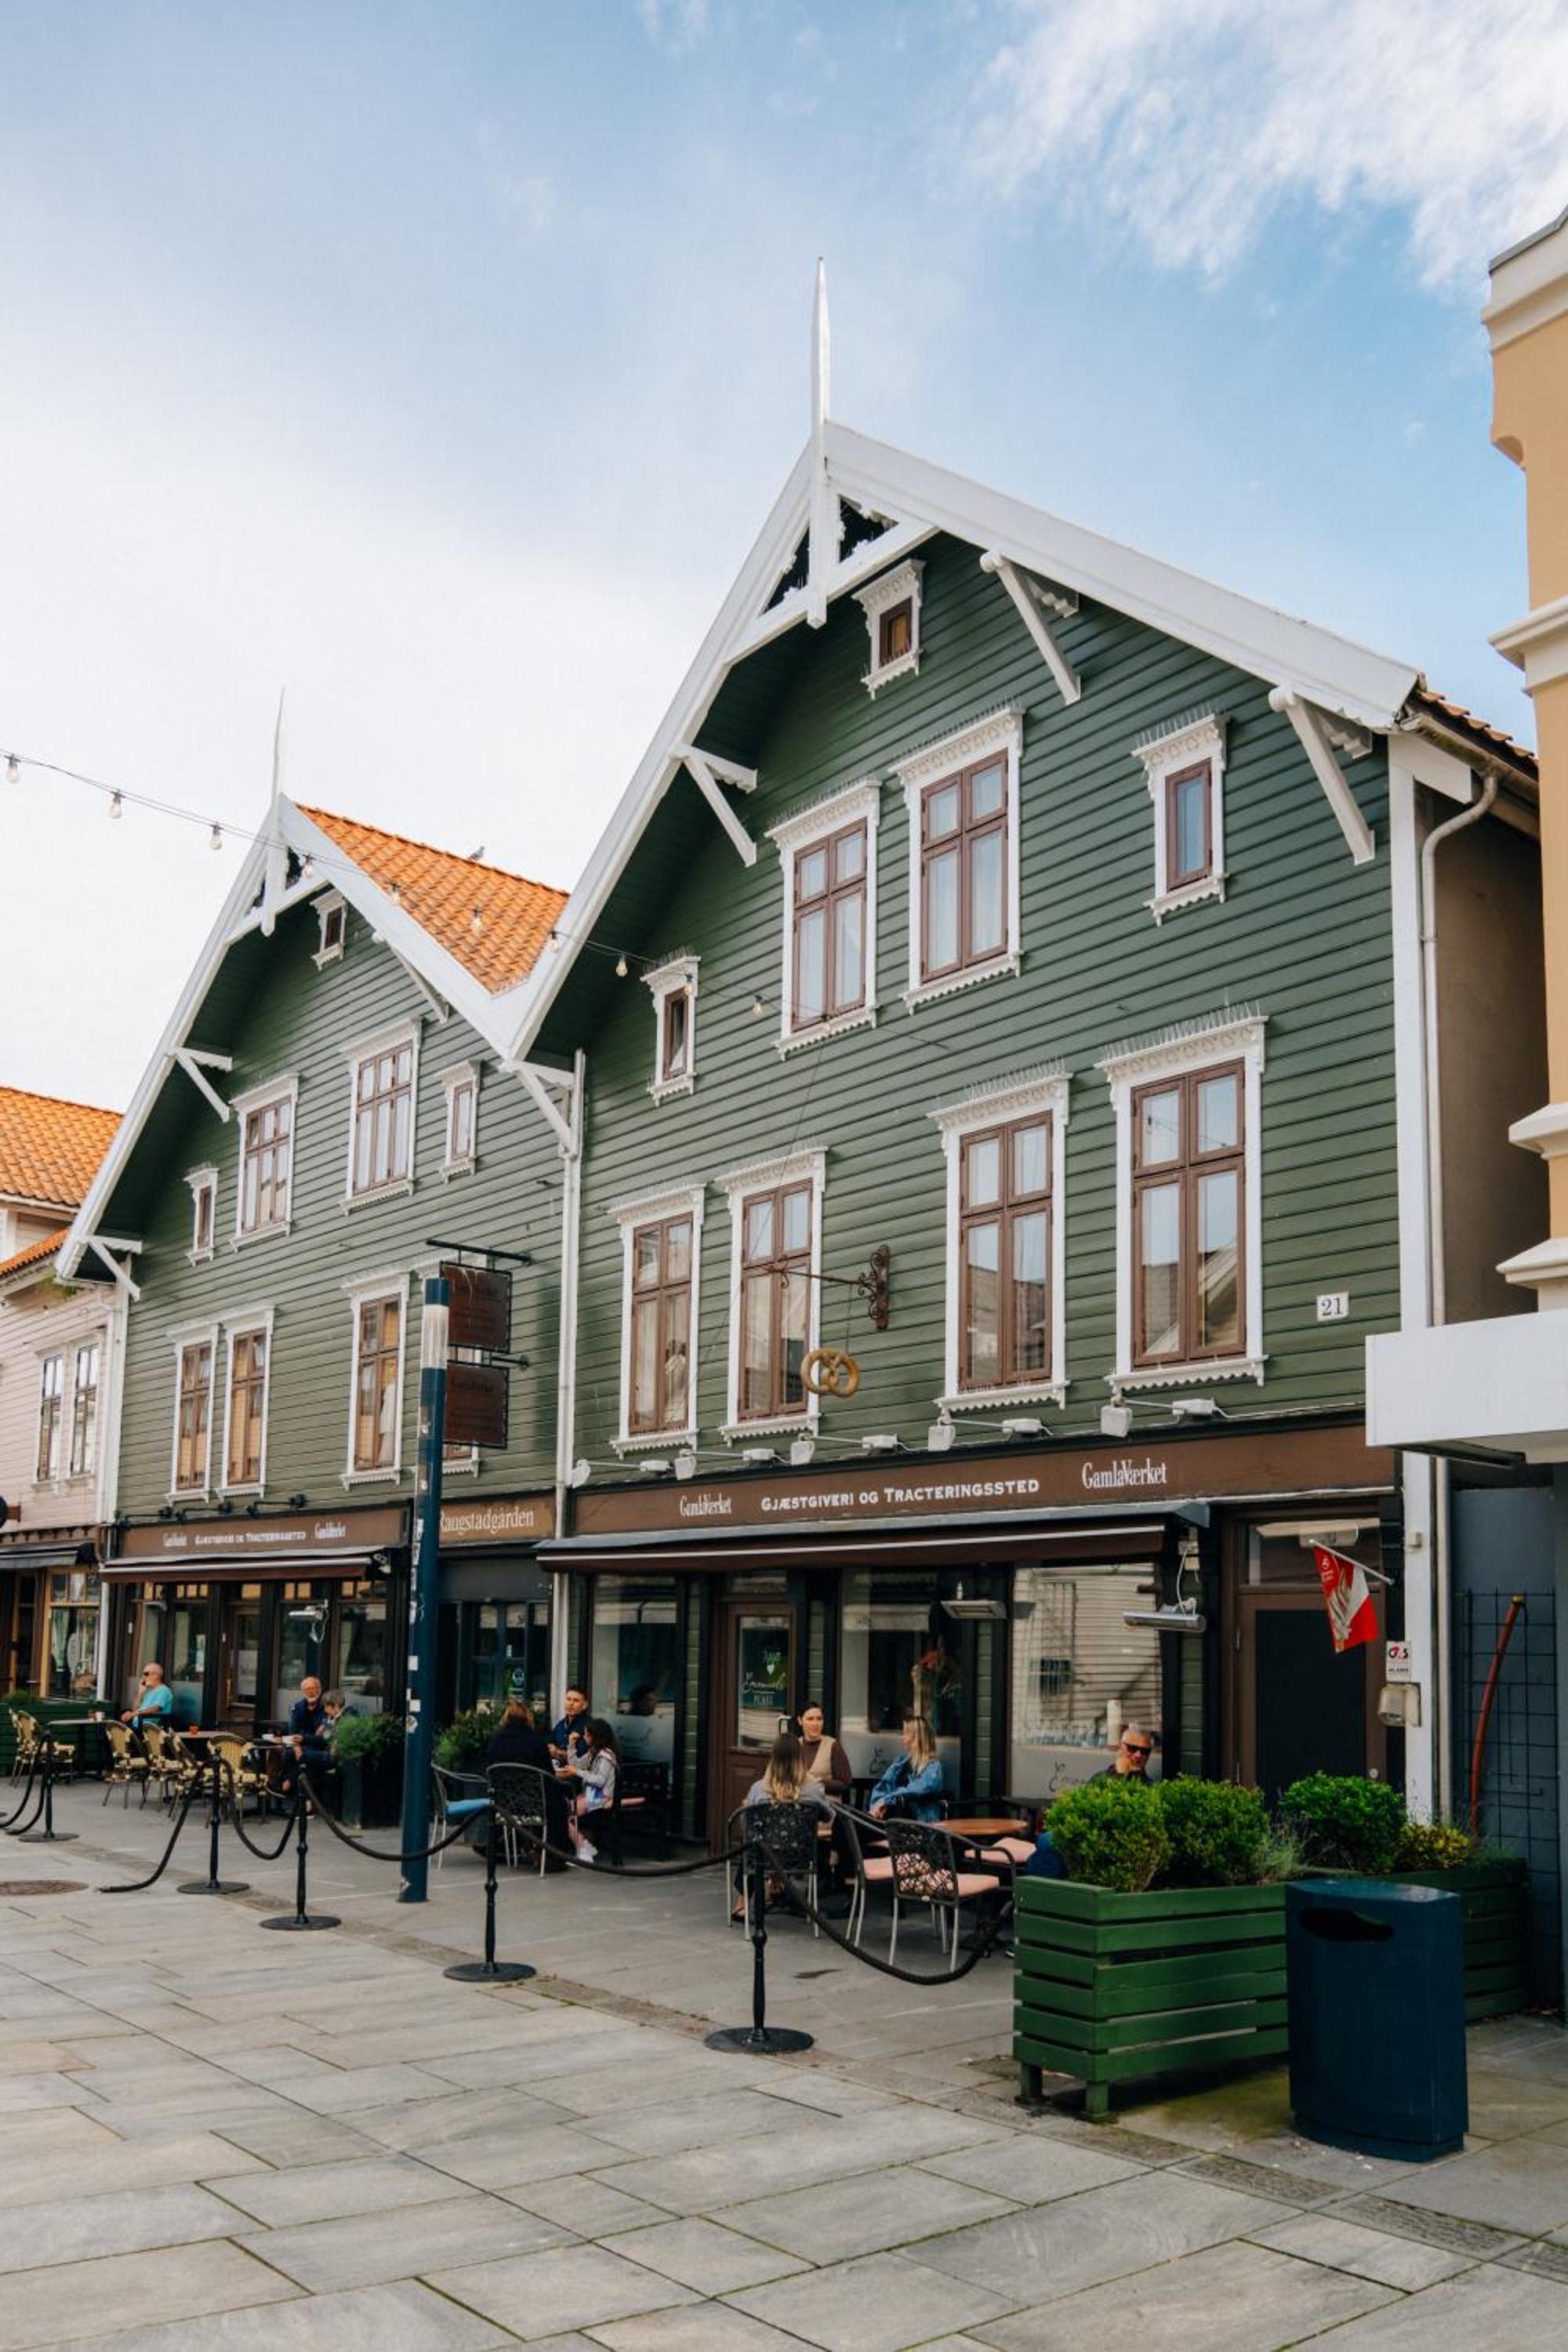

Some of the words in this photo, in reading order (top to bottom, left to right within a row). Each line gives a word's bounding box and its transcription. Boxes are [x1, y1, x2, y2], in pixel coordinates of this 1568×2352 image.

[1321, 1297, 1342, 1316] 21
[1082, 1457, 1167, 1489] GamlaVærket
[858, 1491, 879, 1504] OG
[884, 1479, 1040, 1502] TRACTERINGSSTED
